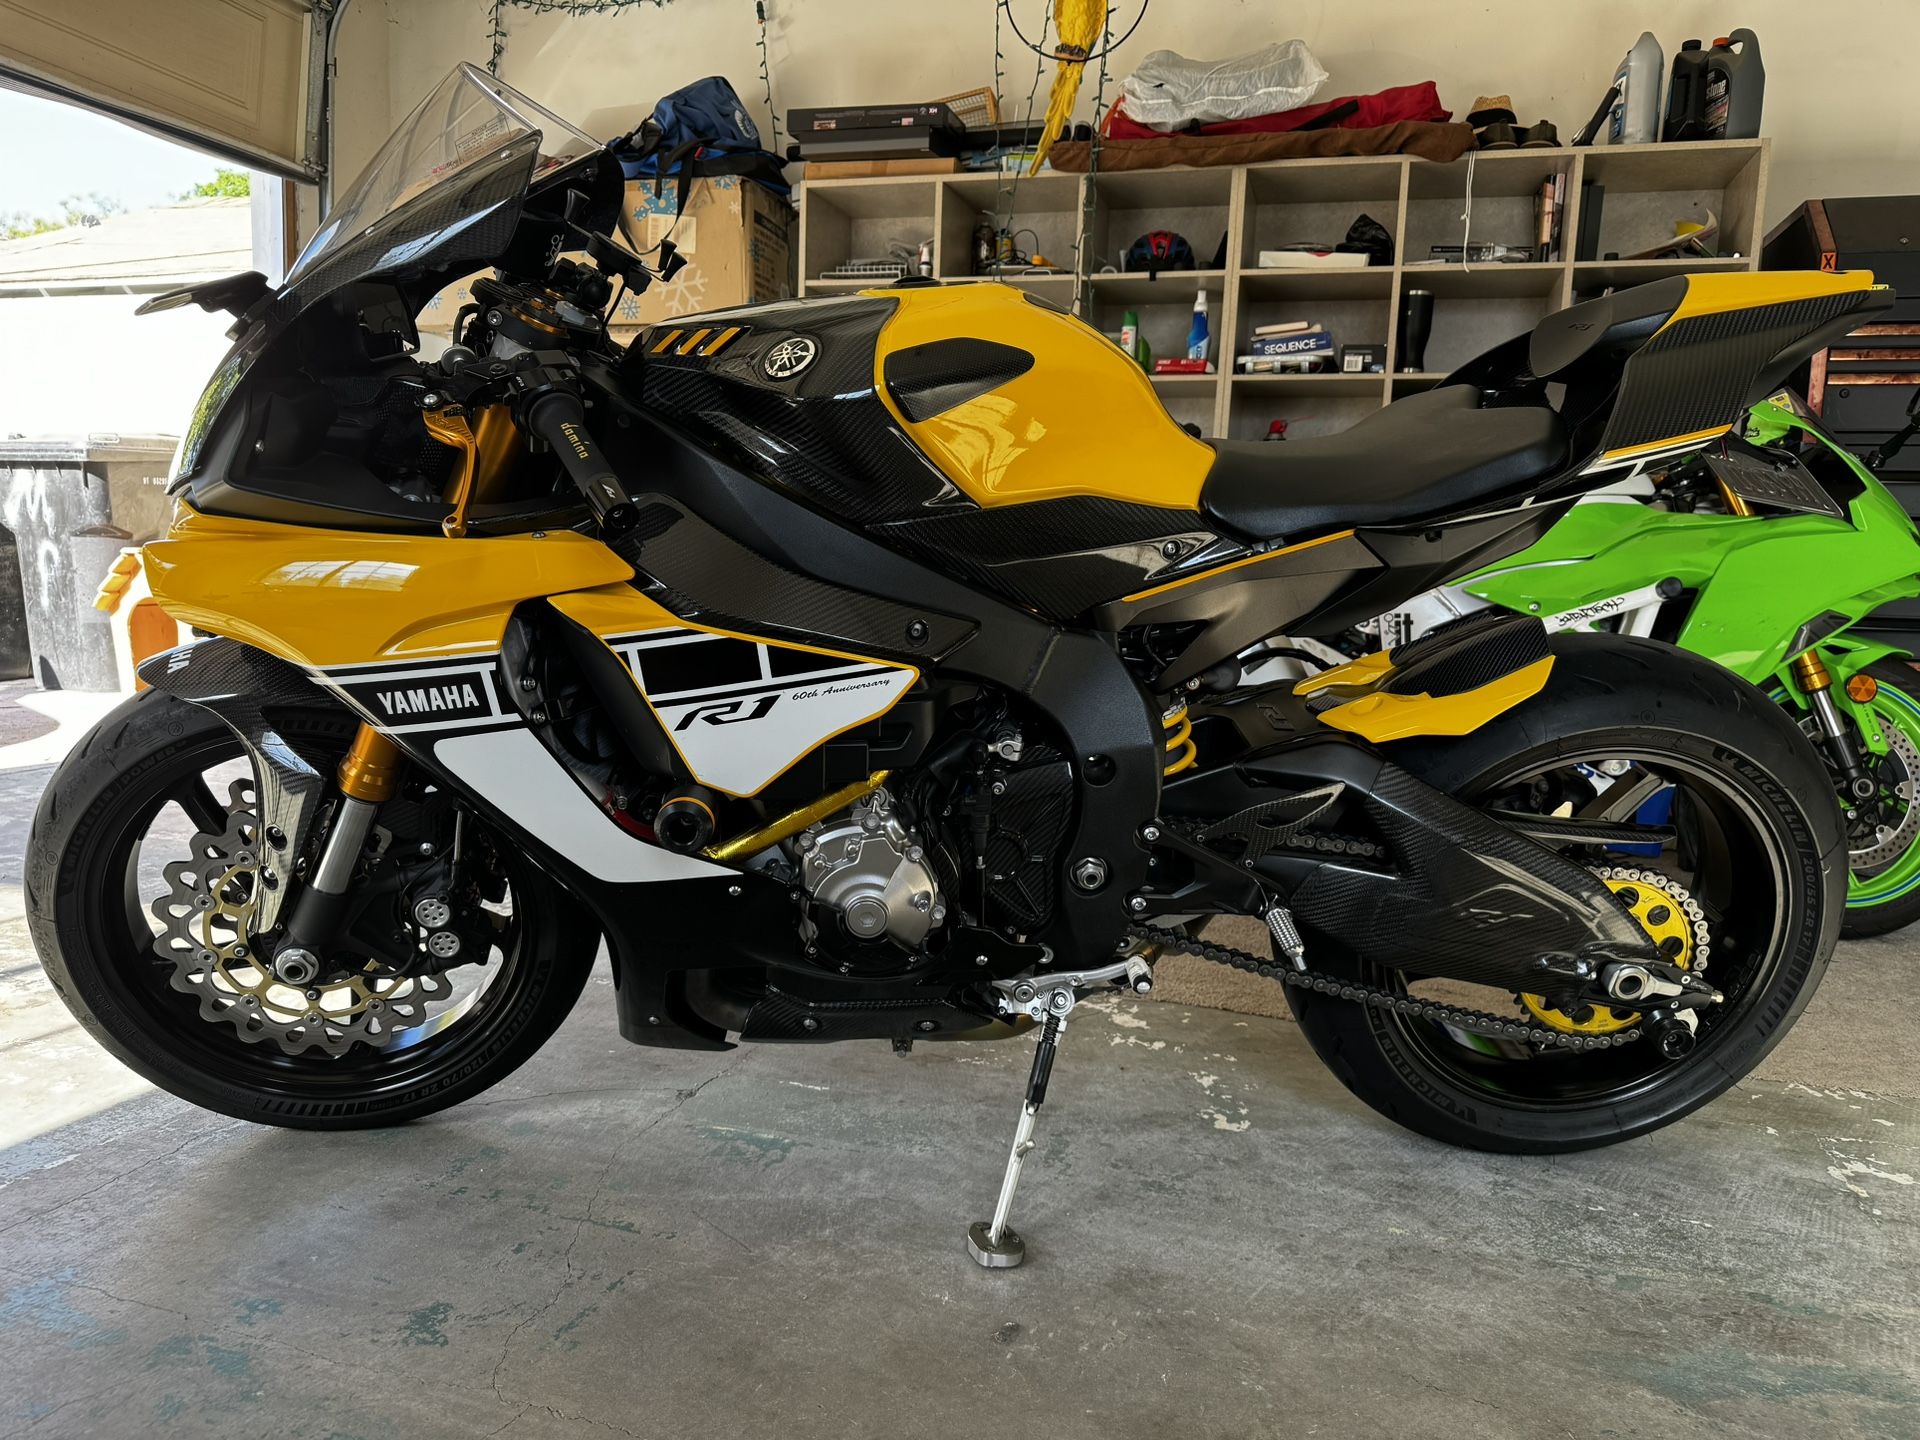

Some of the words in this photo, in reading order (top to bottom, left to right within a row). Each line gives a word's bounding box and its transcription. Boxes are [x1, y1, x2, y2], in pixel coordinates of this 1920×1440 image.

[1264, 338, 1317, 355] SEQUENCE
[377, 683, 480, 715] YAMAHA
[792, 689, 818, 701] 60th
[822, 677, 891, 696] Anniversary
[674, 694, 782, 732] R1
[65, 788, 116, 872] MICHELIN
[121, 744, 177, 785] POWER
[1739, 764, 1809, 850] MICHELIN
[1802, 856, 1817, 909] 200/55
[1804, 909, 1816, 930] ZR
[1801, 930, 1814, 947] 17
[491, 983, 543, 1053] MICHELIN
[442, 1050, 486, 1087] 120/70
[1380, 1036, 1450, 1107] MICHELIN
[403, 1091, 417, 1103] 17
[420, 1084, 440, 1098] ZR
